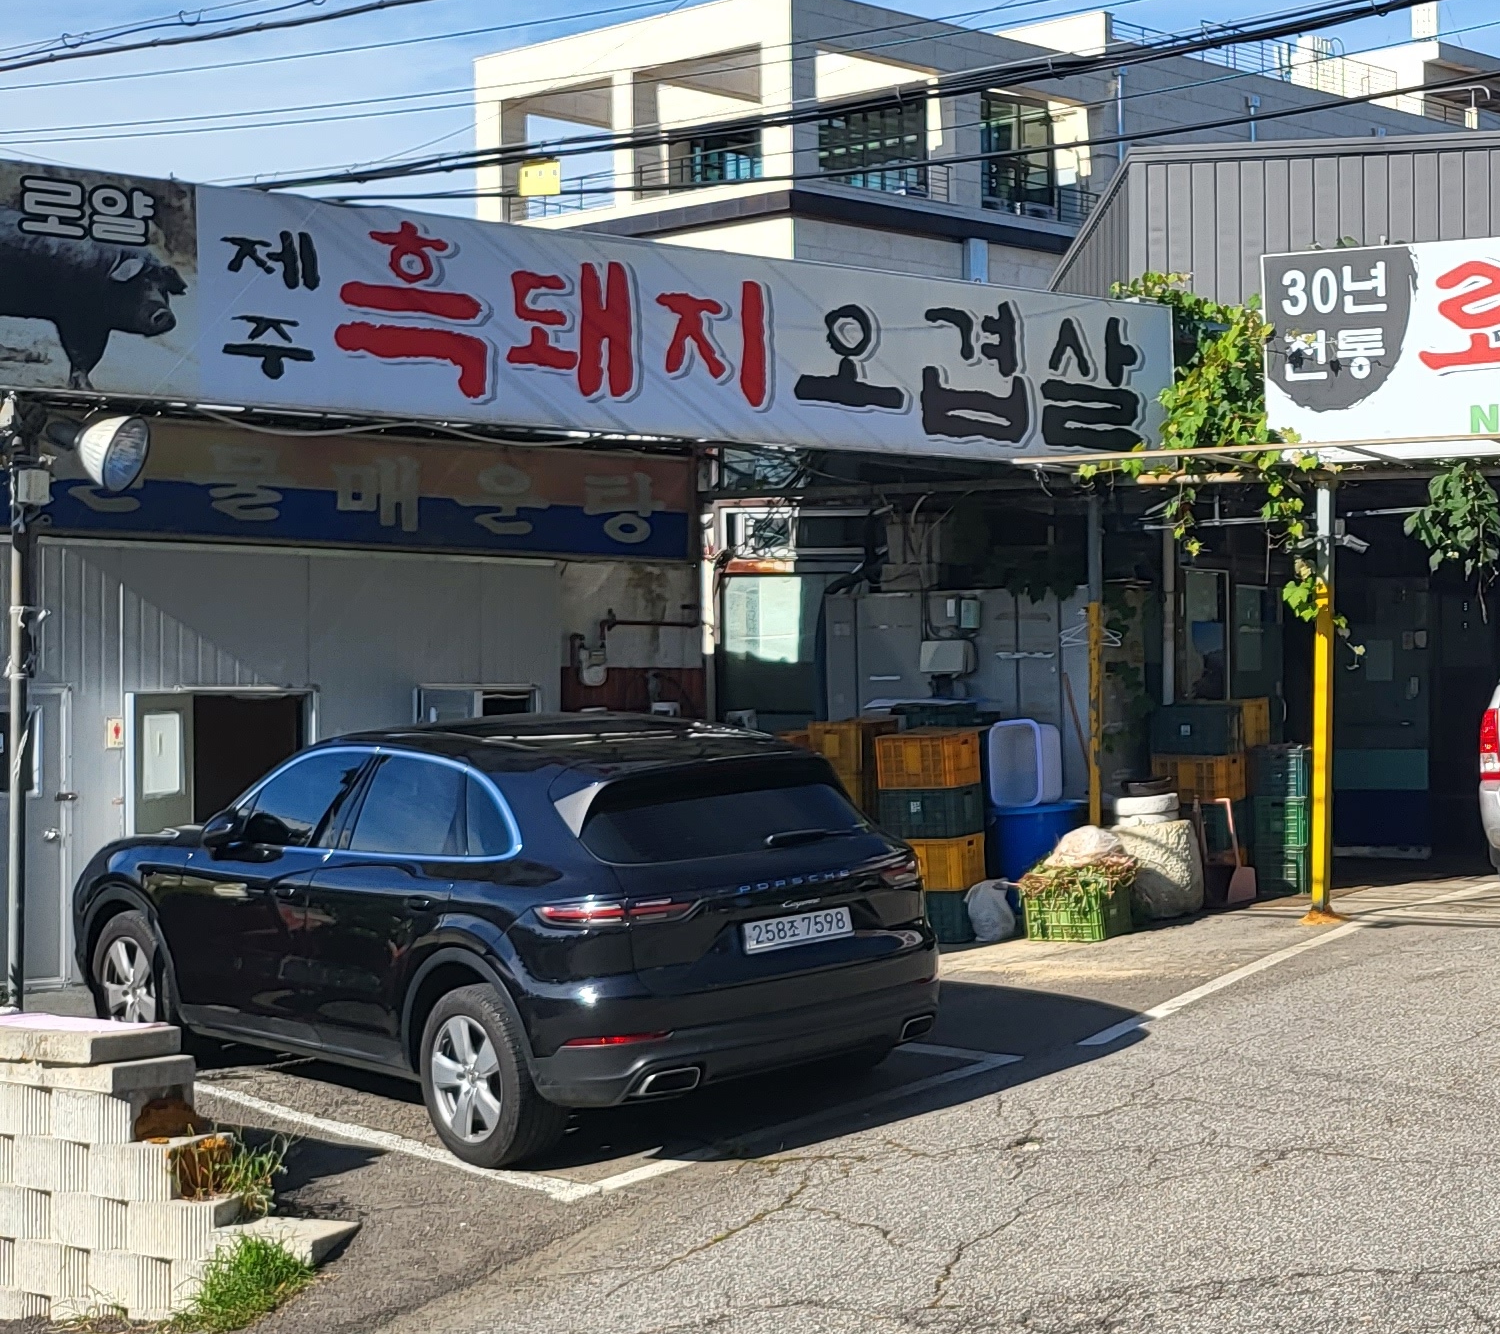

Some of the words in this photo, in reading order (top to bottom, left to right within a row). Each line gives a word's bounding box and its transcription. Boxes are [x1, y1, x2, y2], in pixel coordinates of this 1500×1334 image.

[18, 175, 155, 246] 로얄
[334, 220, 767, 408] 흑돼지
[1280, 259, 1388, 316] 30년
[1284, 327, 1387, 382] 전통
[738, 869, 851, 894] PORSCHE
